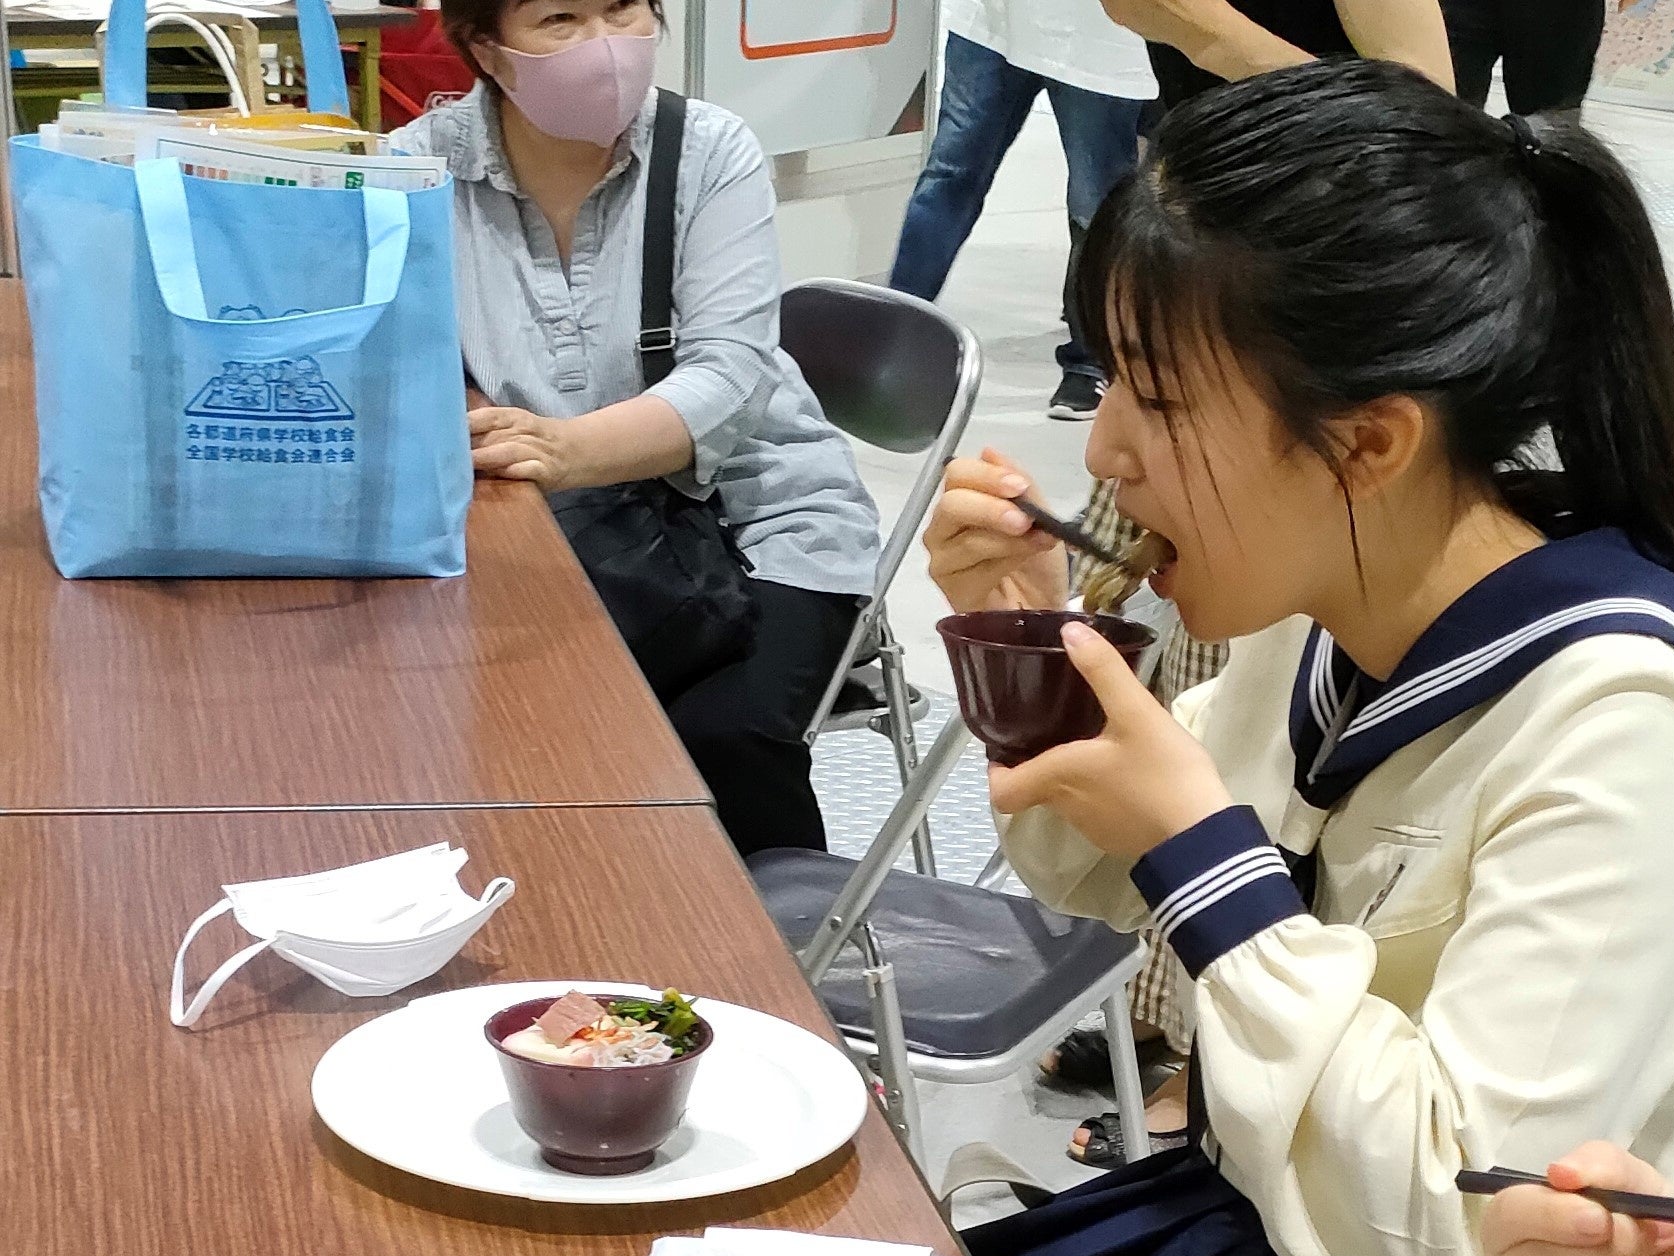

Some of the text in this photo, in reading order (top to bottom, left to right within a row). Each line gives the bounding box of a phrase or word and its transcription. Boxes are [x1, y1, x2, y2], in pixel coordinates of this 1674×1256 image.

[186, 423, 356, 444] 各都道府県学校給食会
[186, 444, 356, 464] 全国学校給食会連合会
